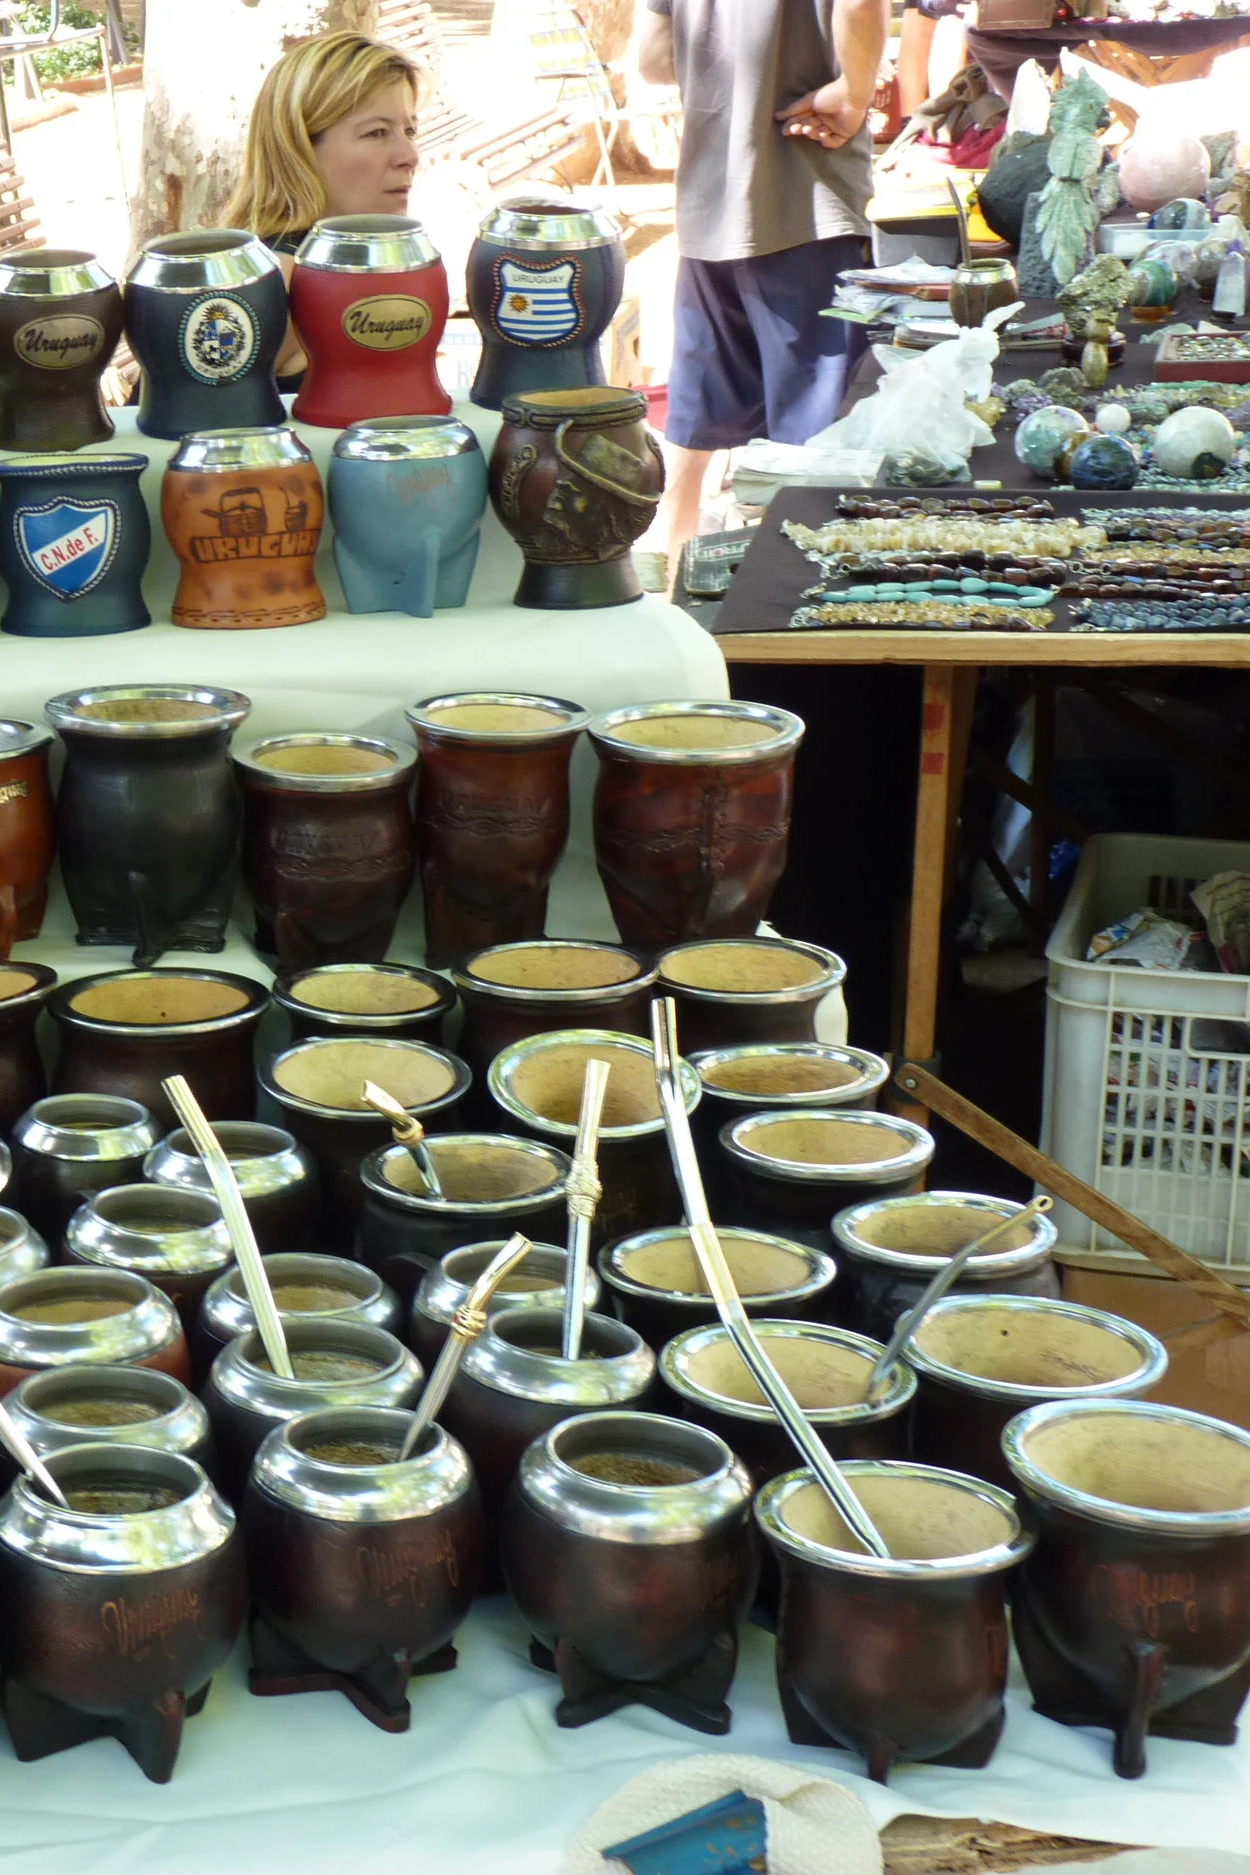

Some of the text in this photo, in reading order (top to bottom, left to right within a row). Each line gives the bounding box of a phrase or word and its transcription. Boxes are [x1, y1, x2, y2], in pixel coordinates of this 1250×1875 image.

[512, 274, 565, 284] URUGUAY
[349, 310, 426, 342] Uruguay
[23, 328, 100, 360] Uruguay
[82, 526, 100, 546] F.
